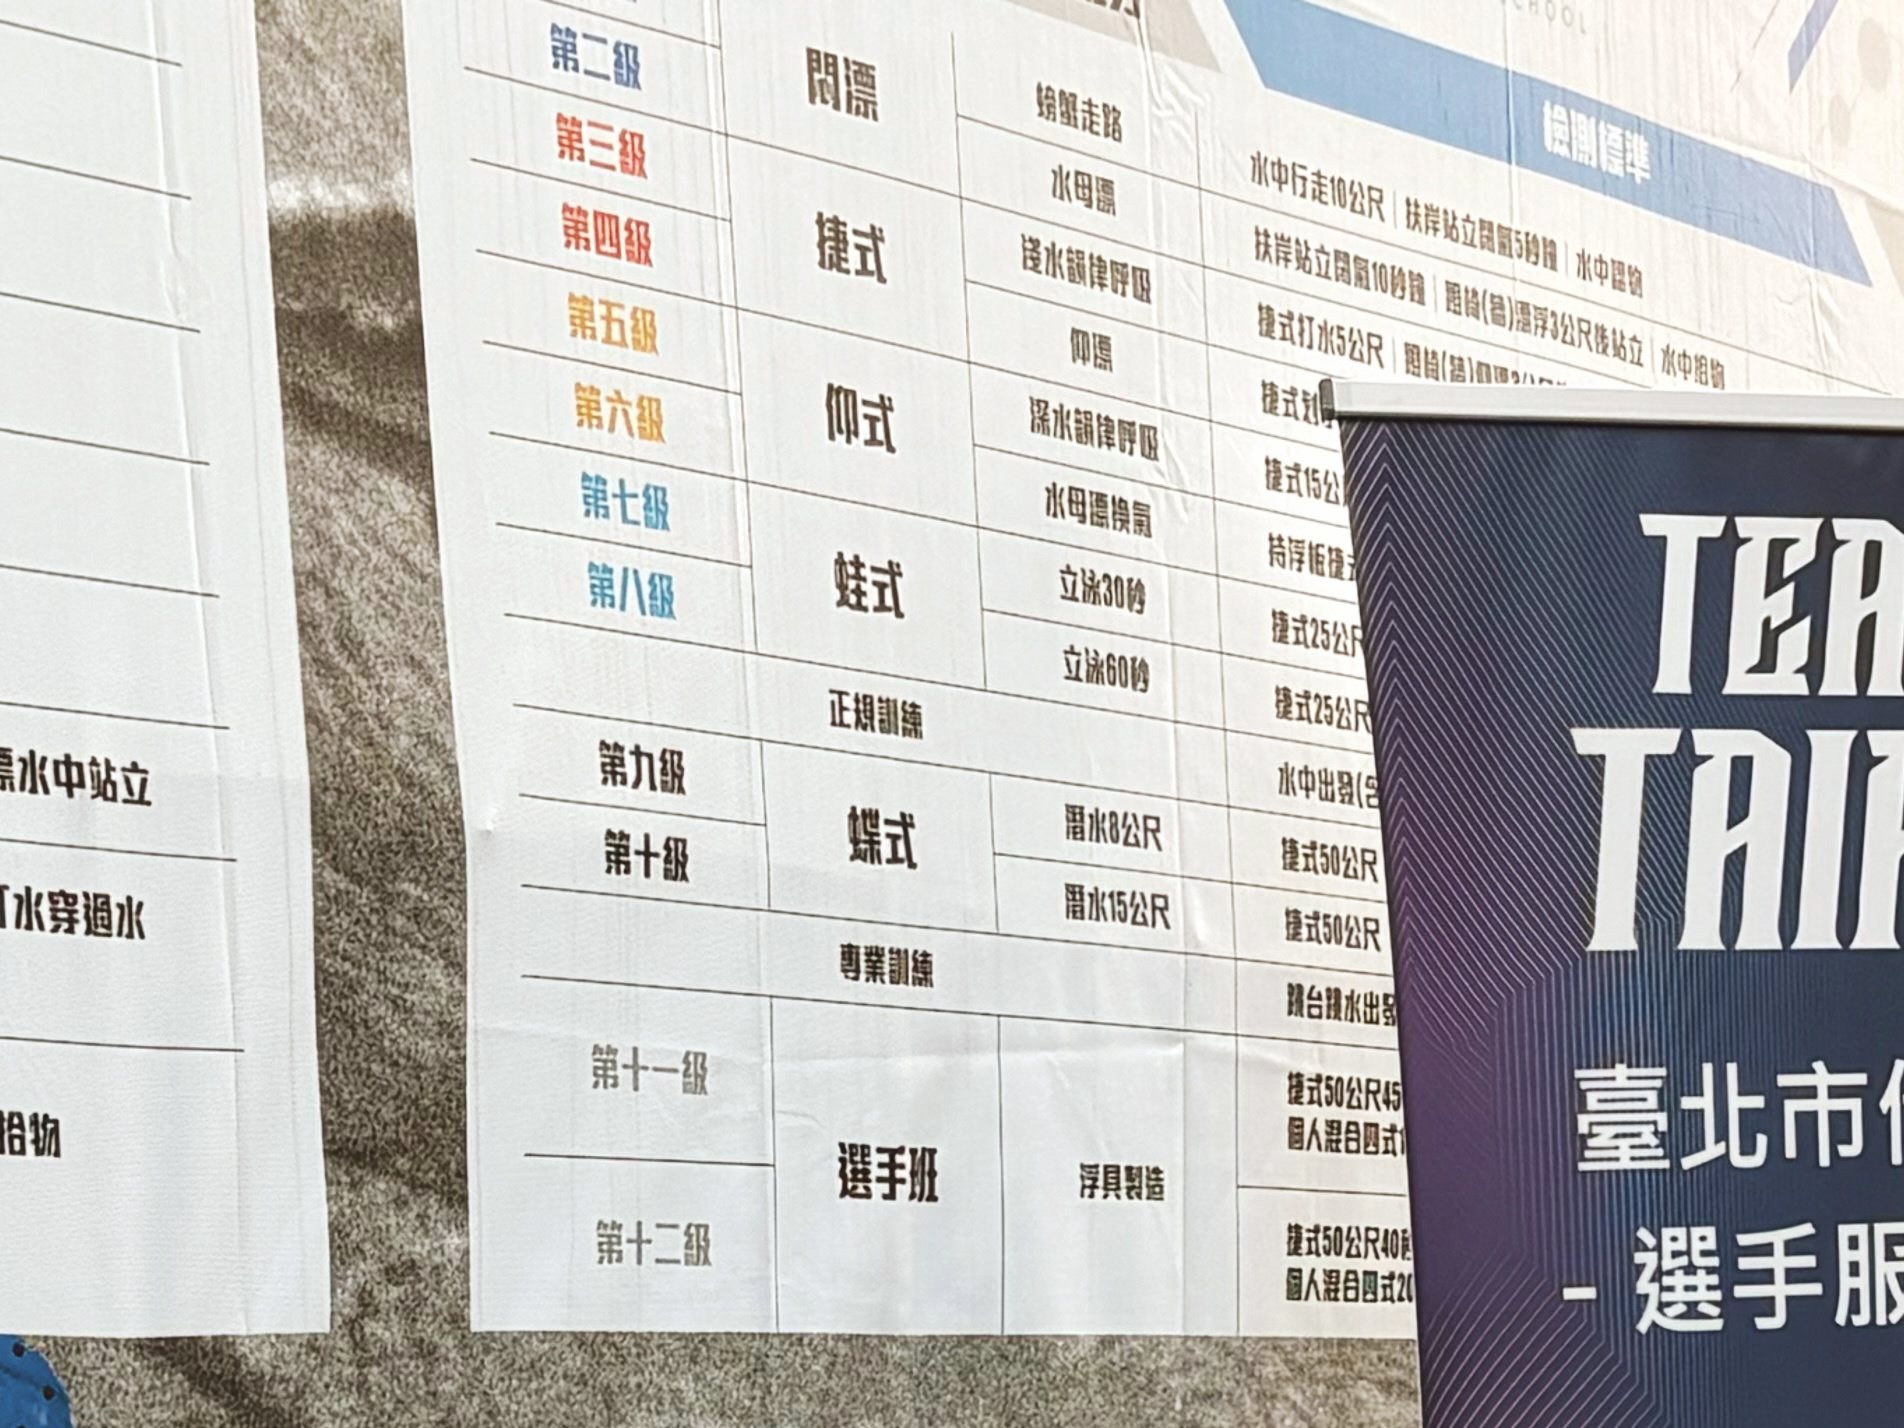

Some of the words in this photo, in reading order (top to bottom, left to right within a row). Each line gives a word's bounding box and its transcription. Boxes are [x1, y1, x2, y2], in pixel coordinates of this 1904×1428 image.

[550, 23, 642, 91] 第二級
[1036, 81, 1122, 143] 螃蟹走路
[556, 114, 647, 181] 第三級
[1543, 99, 1651, 184] 檢測標準
[1051, 164, 1116, 217] 水母漂
[1250, 151, 1384, 225] 水中行走10公尺
[562, 203, 653, 269] 第四級
[816, 212, 886, 285] 捷式
[567, 292, 659, 357] 第五級
[1070, 327, 1113, 373] 仰漂
[1258, 301, 1384, 369] 捷式打水5公尺
[574, 382, 665, 446] 第六級
[826, 382, 896, 454] 仰式
[1029, 396, 1158, 462] 深水韻律呼吸
[1262, 379, 1332, 428] 捷式划
[580, 472, 670, 533] 第七級
[1045, 481, 1152, 538] 水母漂換氣
[1265, 455, 1346, 507] 捷式15公
[587, 562, 676, 621] 第八級
[834, 551, 904, 620] 蛙式
[1059, 564, 1146, 615] 立泳30秒
[1063, 645, 1149, 694] 立泳60秒
[829, 688, 923, 741] 正規訓練
[1275, 684, 1372, 734] 捷式25公尺
[598, 739, 686, 797] 第九級
[604, 828, 689, 884] 第十級
[848, 806, 917, 871] 蝶式
[1064, 804, 1163, 853] 潛水8公尺
[1282, 837, 1378, 883] 捷式50公尺
[1064, 882, 1171, 931] 潛水15公尺
[1285, 907, 1381, 951] 捷式50公尺
[839, 943, 934, 989] 專業訓練
[592, 1044, 708, 1096] 第十一級
[838, 1142, 940, 1204] 選手班
[1078, 1162, 1166, 1203] 浮具製造
[596, 1220, 711, 1268] 第十二級
